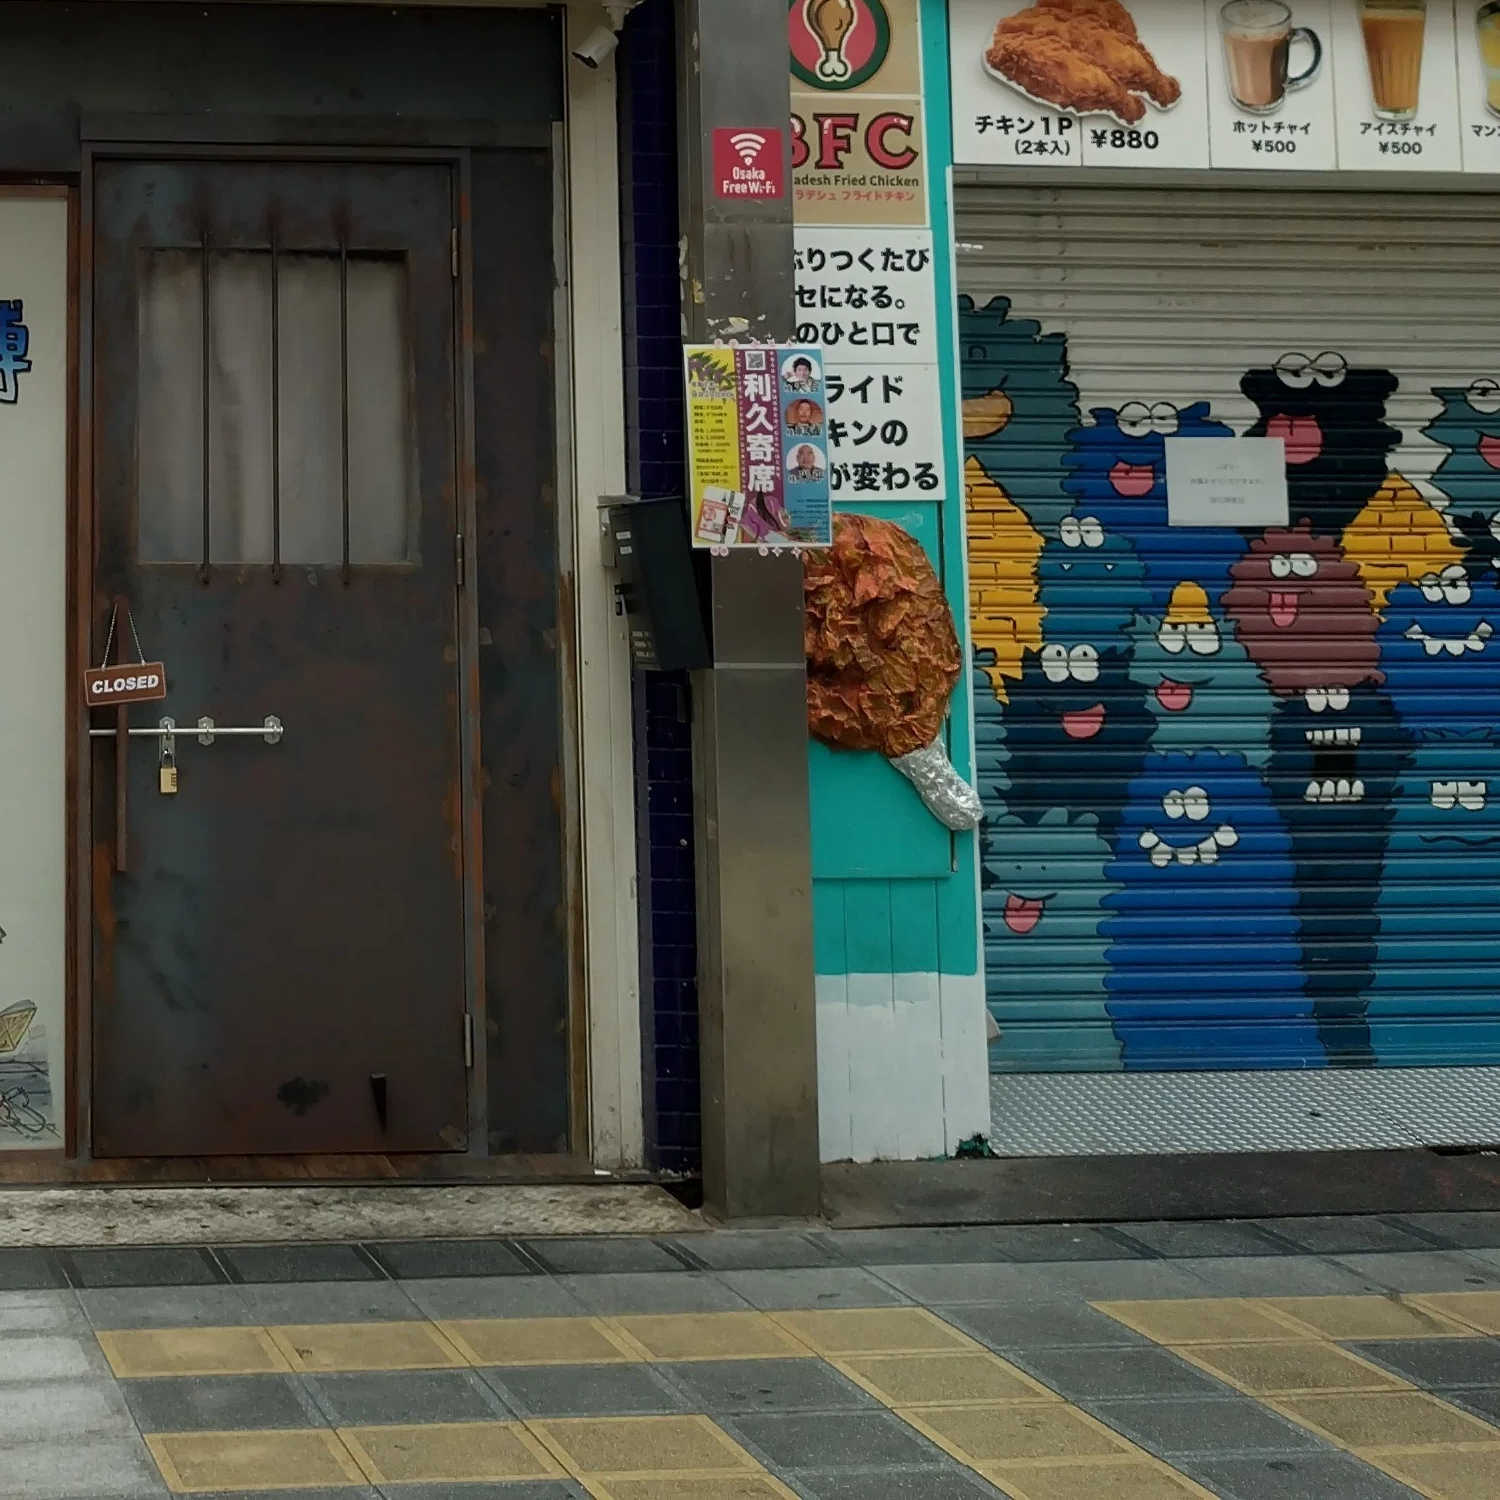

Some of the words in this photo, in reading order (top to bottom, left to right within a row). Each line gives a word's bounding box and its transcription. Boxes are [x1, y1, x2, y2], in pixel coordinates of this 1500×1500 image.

[1233, 120, 1311, 135] ホットチャイ
[1360, 122, 1437, 136] アイスチャイ
[1471, 124, 1500, 137] マン
[1091, 129, 1159, 149] ¥880
[1251, 140, 1296, 153] ¥500
[1014, 139, 1071, 156] (2本入)
[1379, 141, 1422, 154] ¥500
[732, 166, 766, 180] Osaka
[834, 174, 867, 187] Fried
[869, 174, 919, 188] Chicken
[723, 180, 748, 194] Free
[748, 180, 776, 194] Wi-Fi
[795, 284, 905, 310] セになる。
[797, 321, 921, 346] のひと口で
[824, 375, 904, 404] ライド
[742, 373, 775, 493] 利久寄席
[828, 419, 908, 448] キンの
[91, 674, 160, 695] CLOSED
